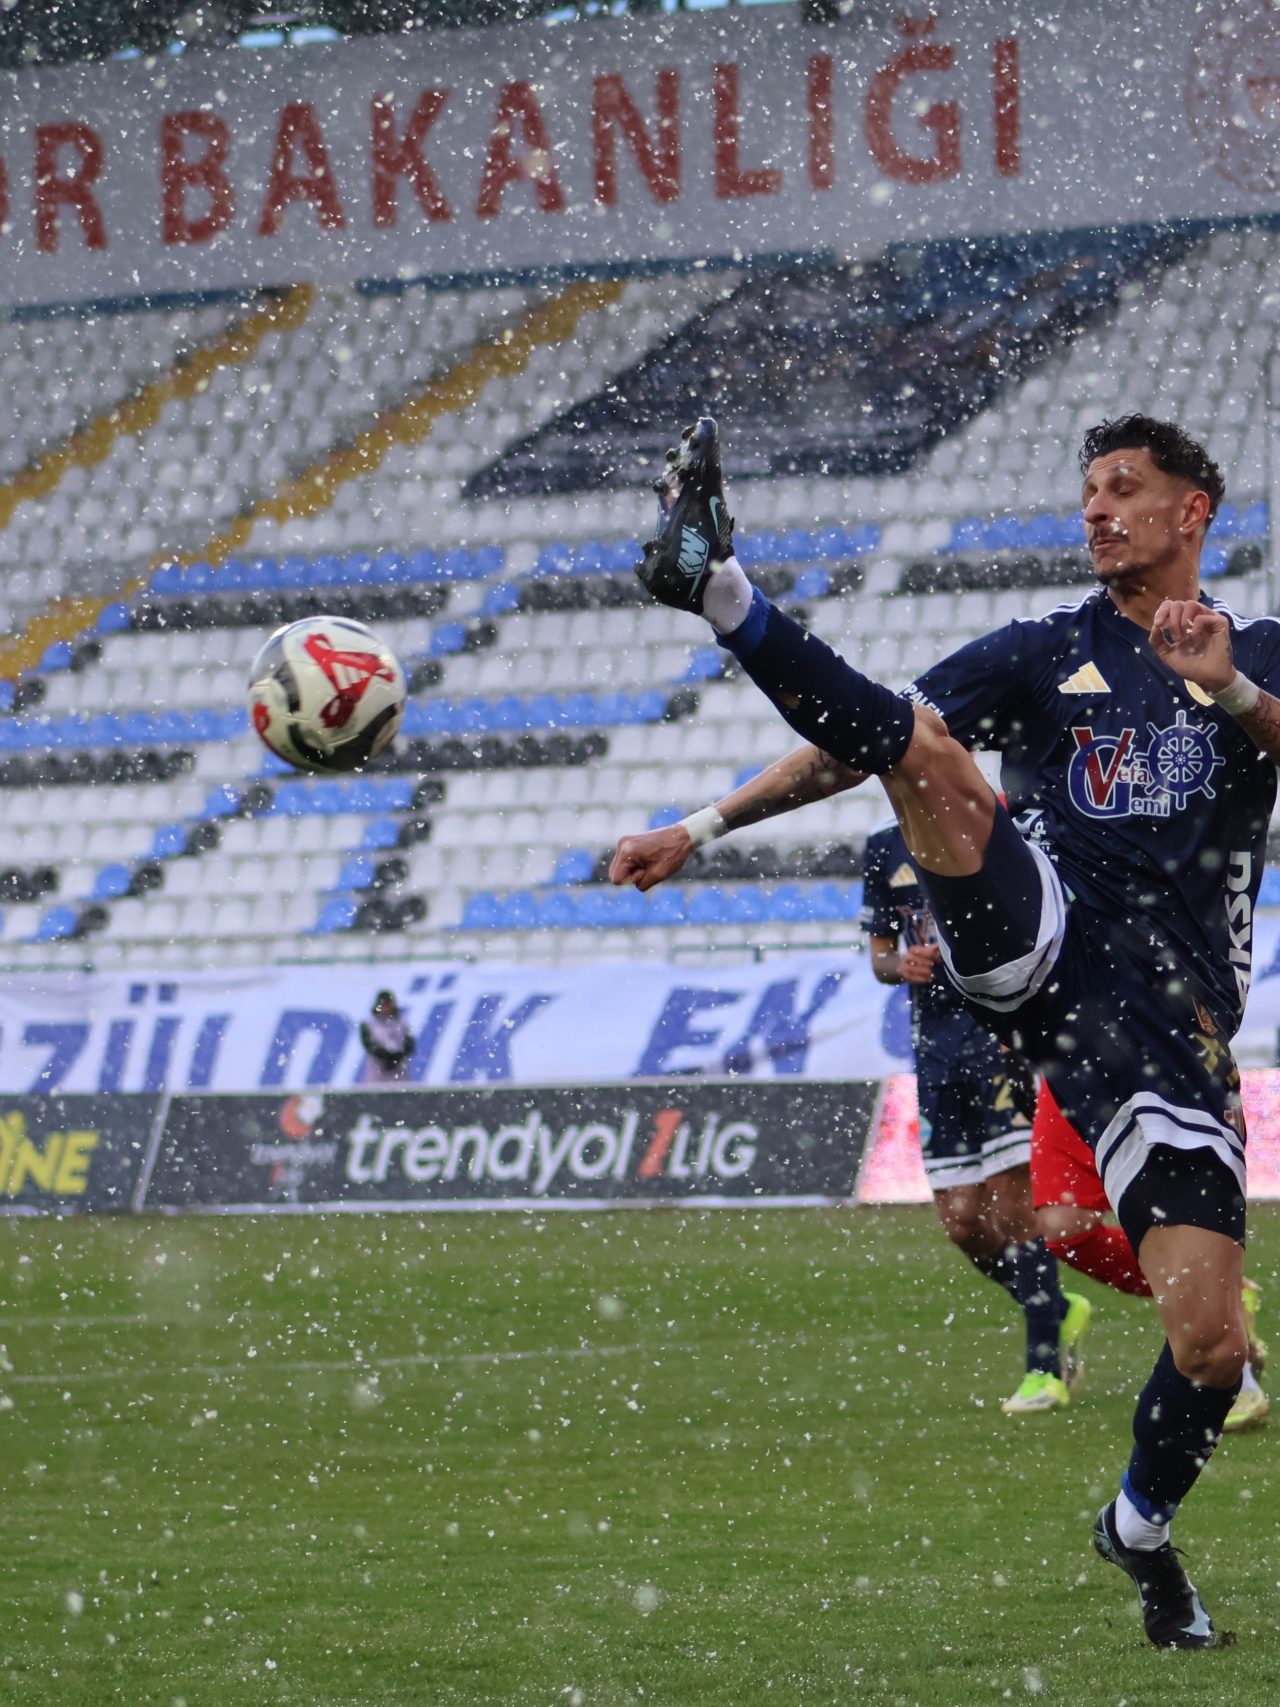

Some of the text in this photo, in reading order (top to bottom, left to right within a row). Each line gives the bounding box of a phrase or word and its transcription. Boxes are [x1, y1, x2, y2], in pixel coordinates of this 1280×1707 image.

[0, 119, 107, 252] R
[159, 13, 1021, 247] BAKANLIĞI
[346, 1108, 639, 1195] trendyol
